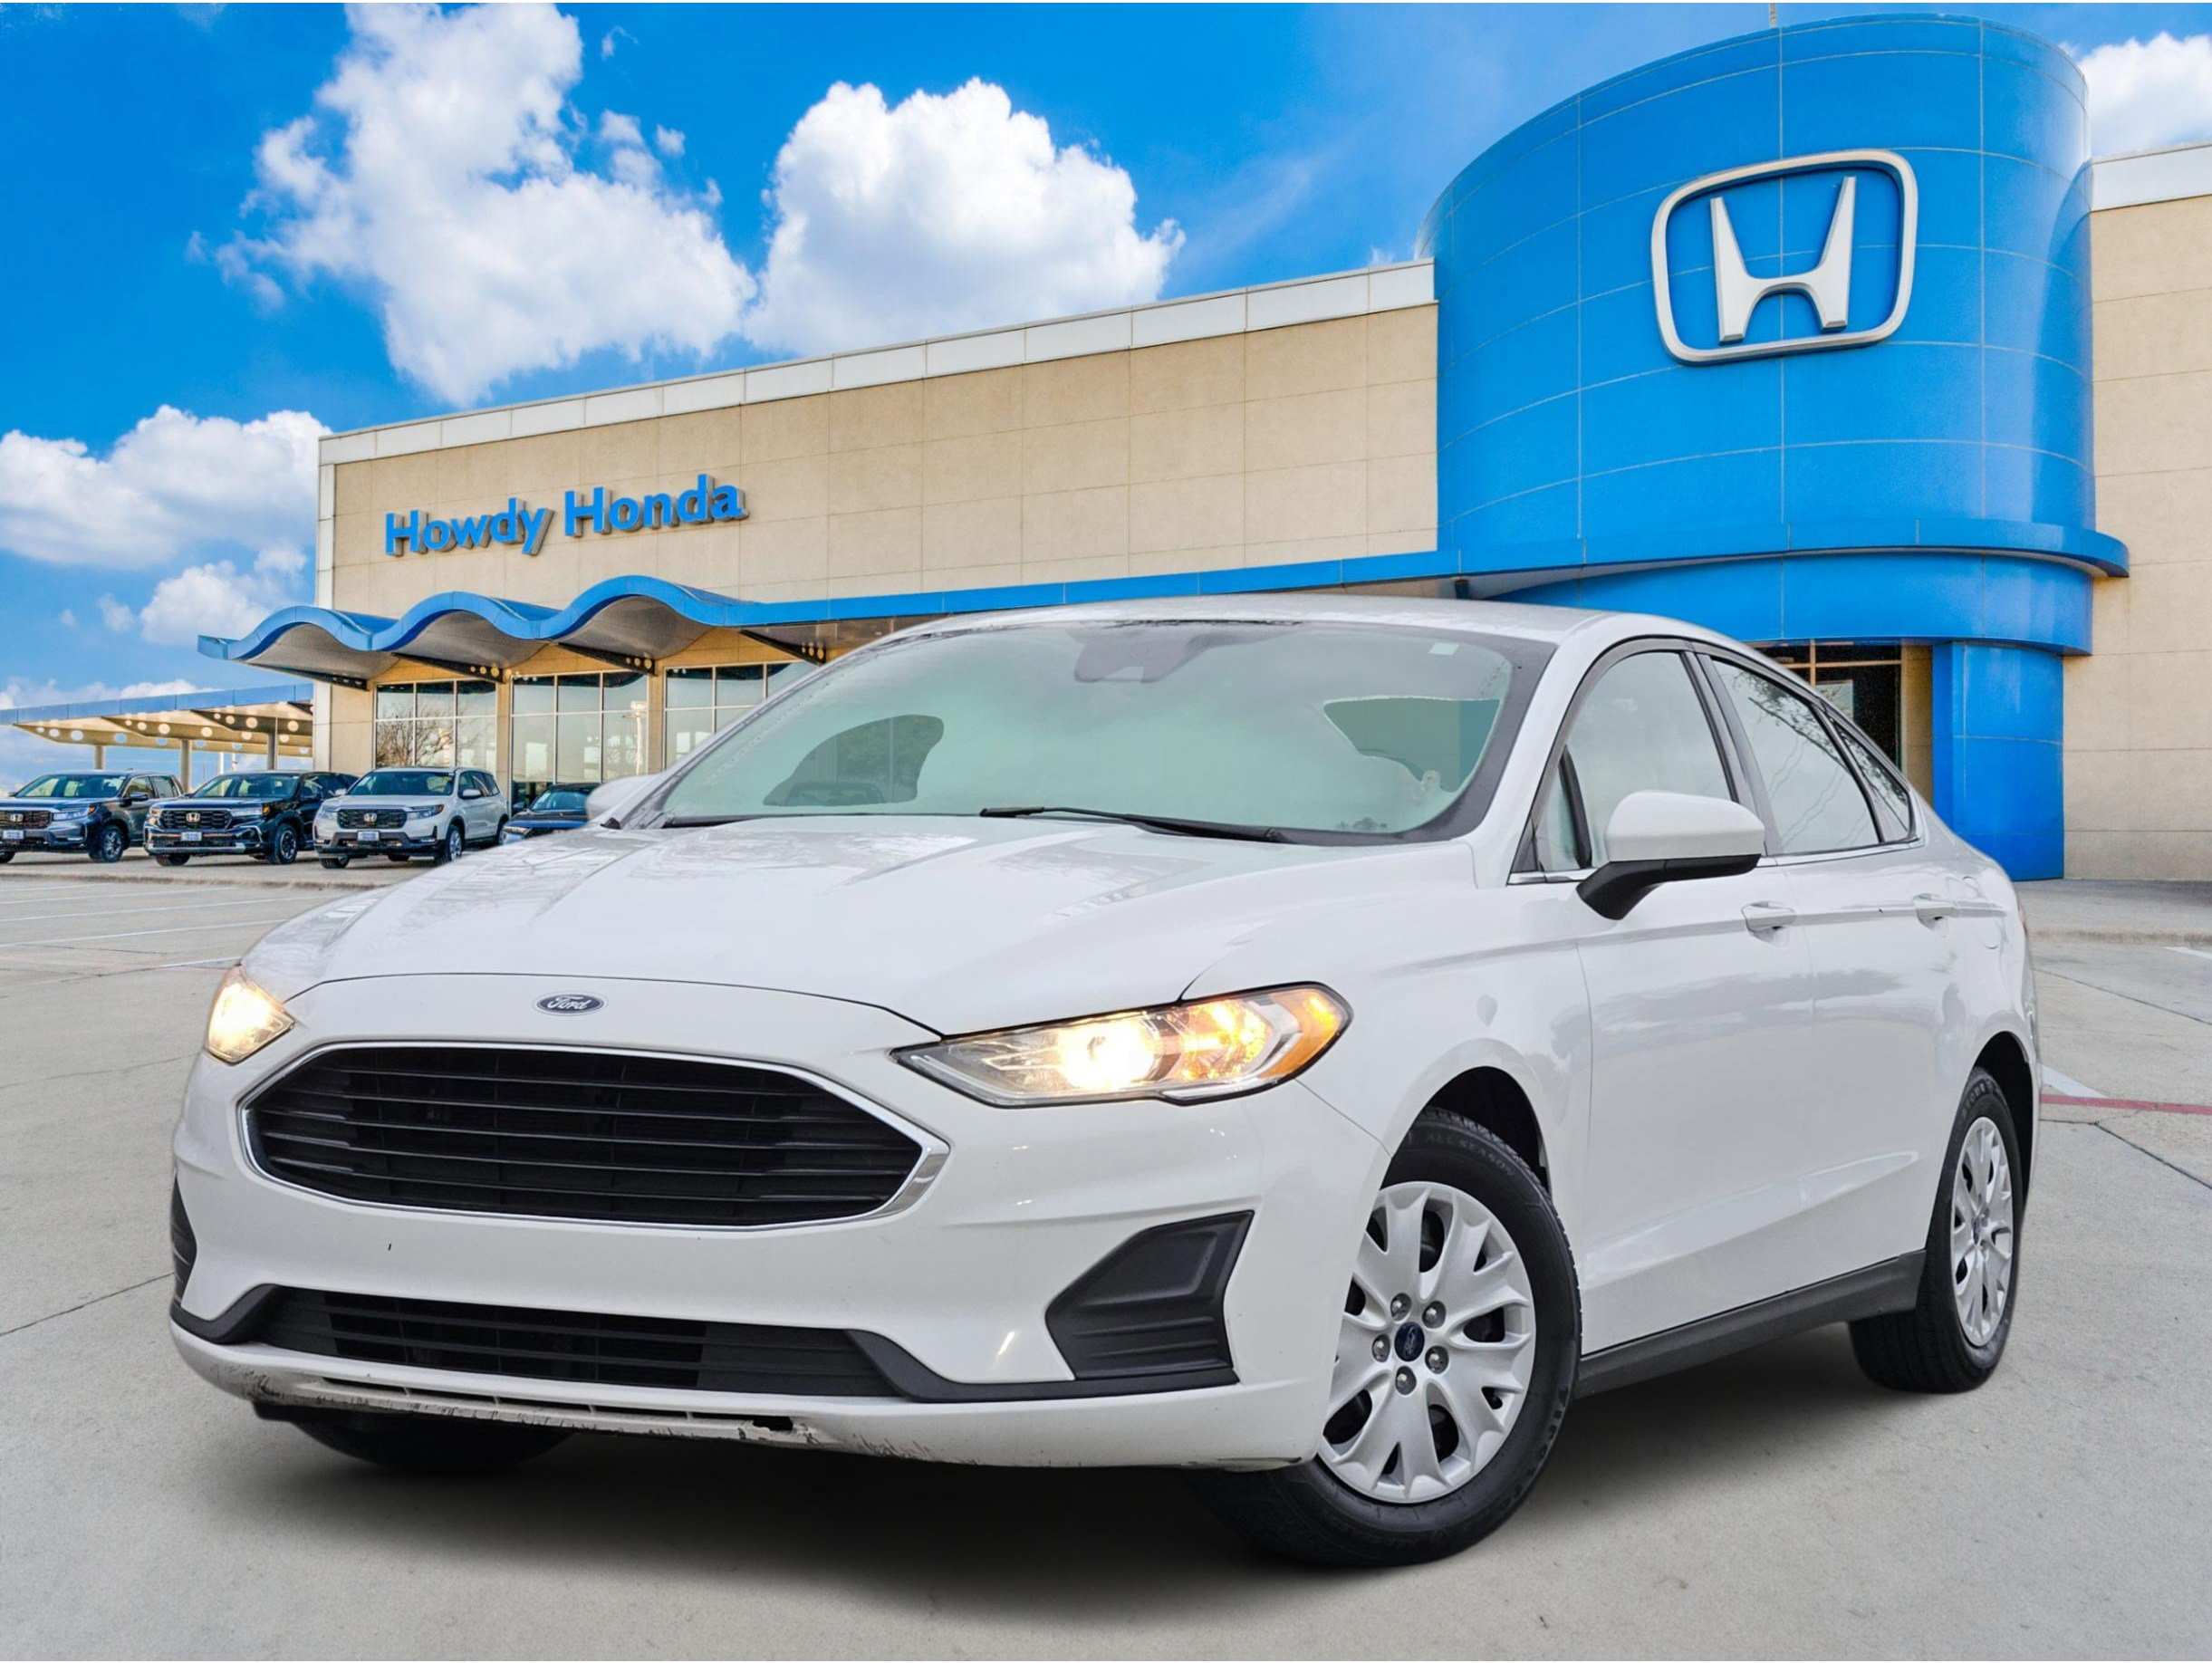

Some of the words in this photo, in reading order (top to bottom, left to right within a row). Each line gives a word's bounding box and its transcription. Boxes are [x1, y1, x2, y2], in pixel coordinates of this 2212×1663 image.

[1710, 176, 1856, 344] H
[385, 497, 554, 556] Howdy
[564, 474, 747, 537] Honda
[546, 995, 591, 1010] Ford
